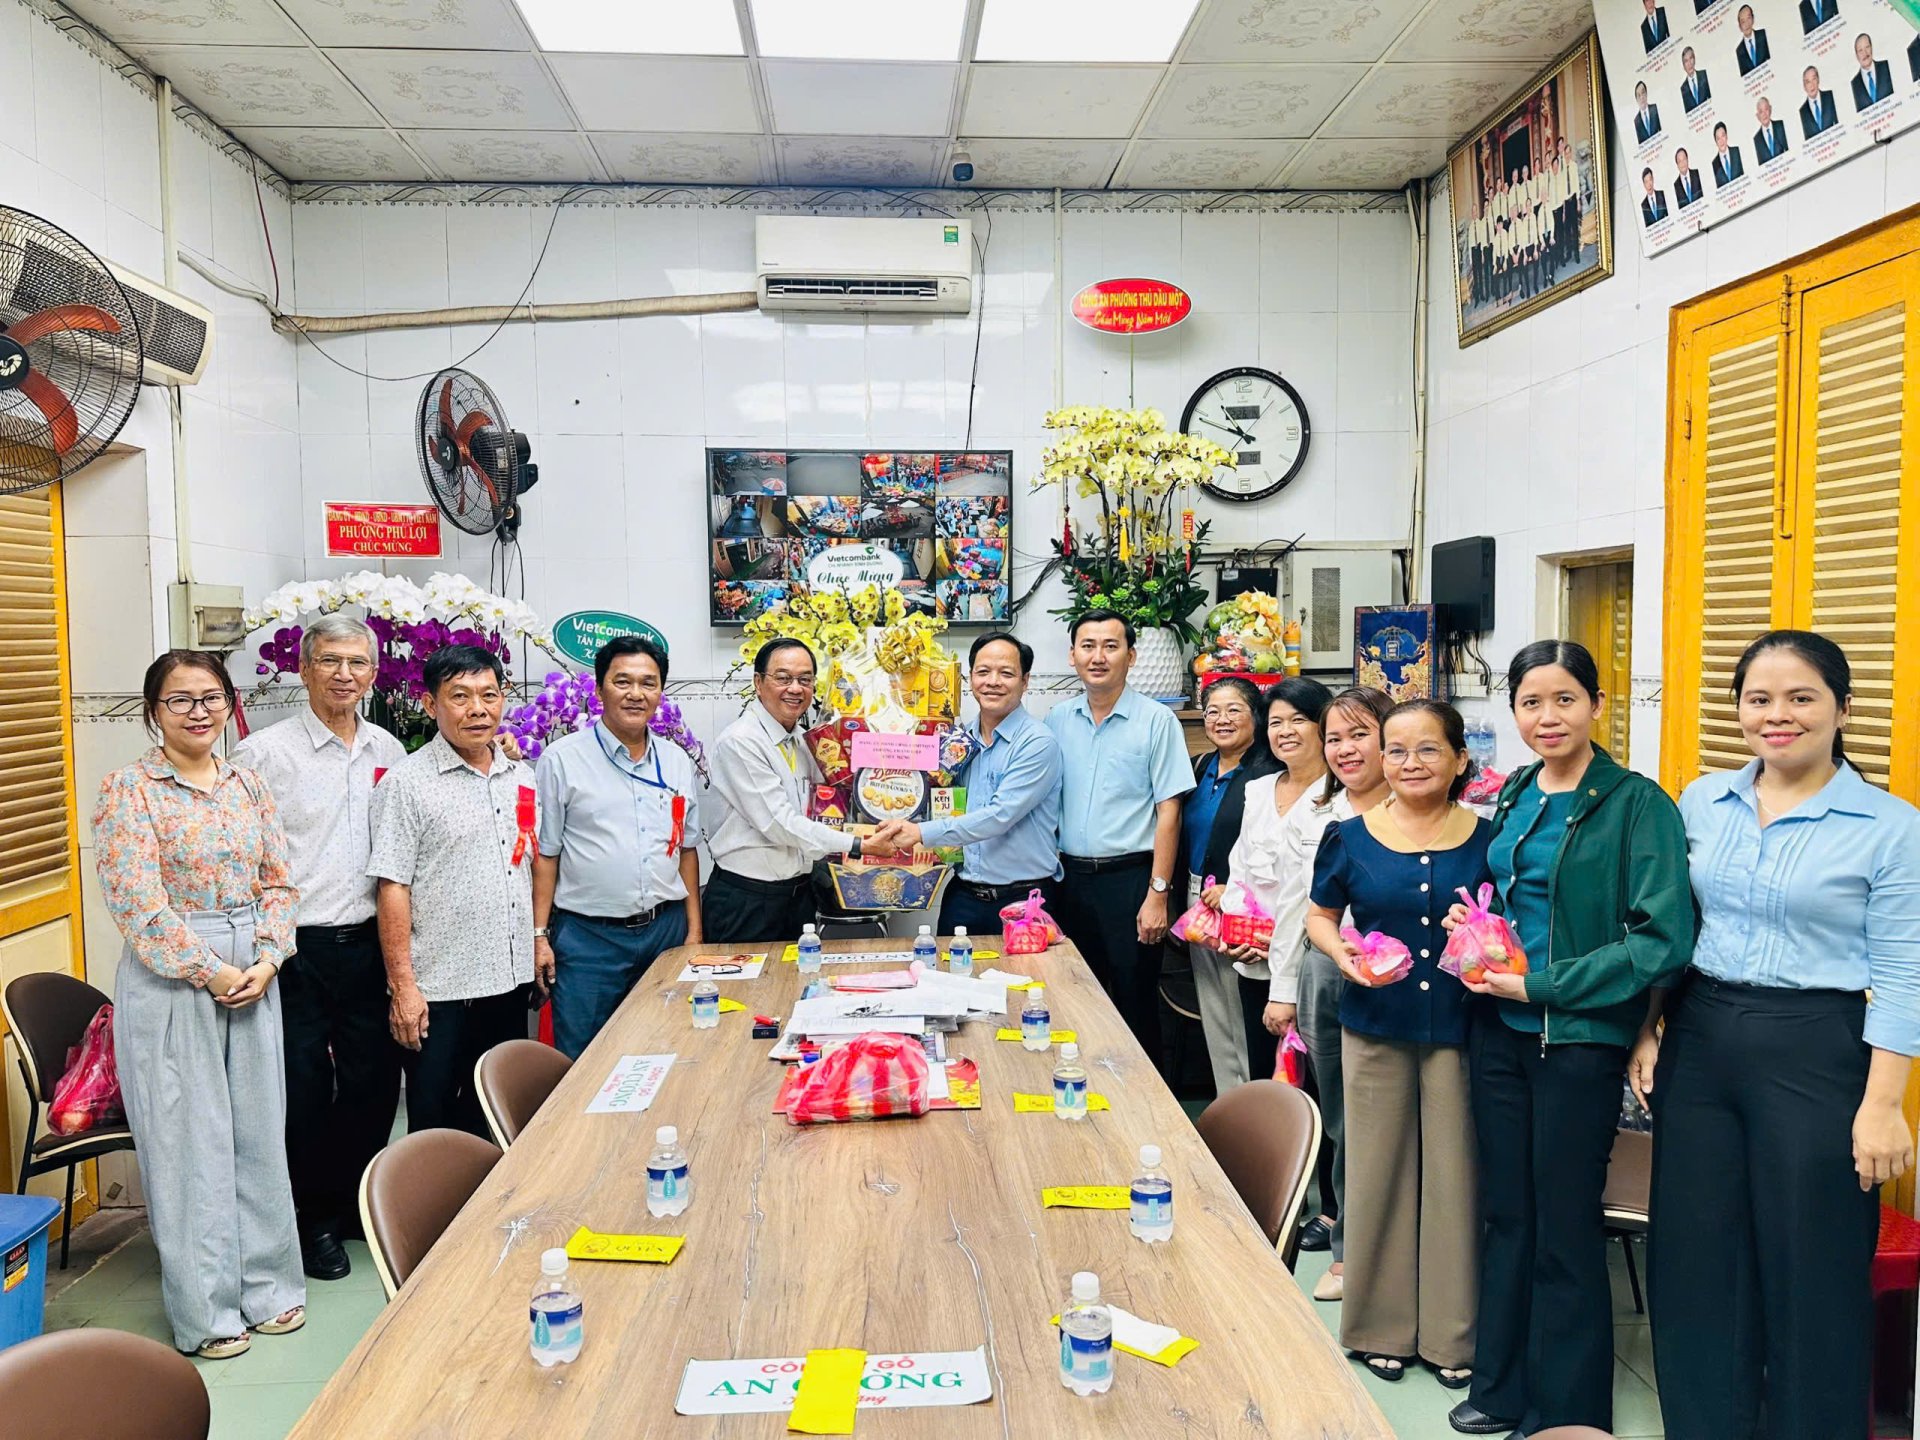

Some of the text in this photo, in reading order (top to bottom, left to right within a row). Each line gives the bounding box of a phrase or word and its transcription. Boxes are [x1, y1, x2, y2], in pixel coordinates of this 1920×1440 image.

[1109, 289, 1138, 307] PHƯỜNG
[1139, 288, 1153, 307] THỦ
[1168, 289, 1183, 309] MỘT
[1234, 379, 1252, 393] 12
[1286, 426, 1299, 440] 3
[1238, 478, 1251, 492] 6
[340, 522, 428, 543] PHƯỜNG PHÚ LỢI
[353, 541, 412, 553] CHÚC MỪNG
[827, 554, 881, 563] Vietcombank
[576, 633, 593, 646] TÂN
[869, 767, 912, 781] Danisa
[631, 1059, 652, 1072] AN
[761, 1355, 915, 1373] CÔ GỖ
[706, 1378, 780, 1397] AN
